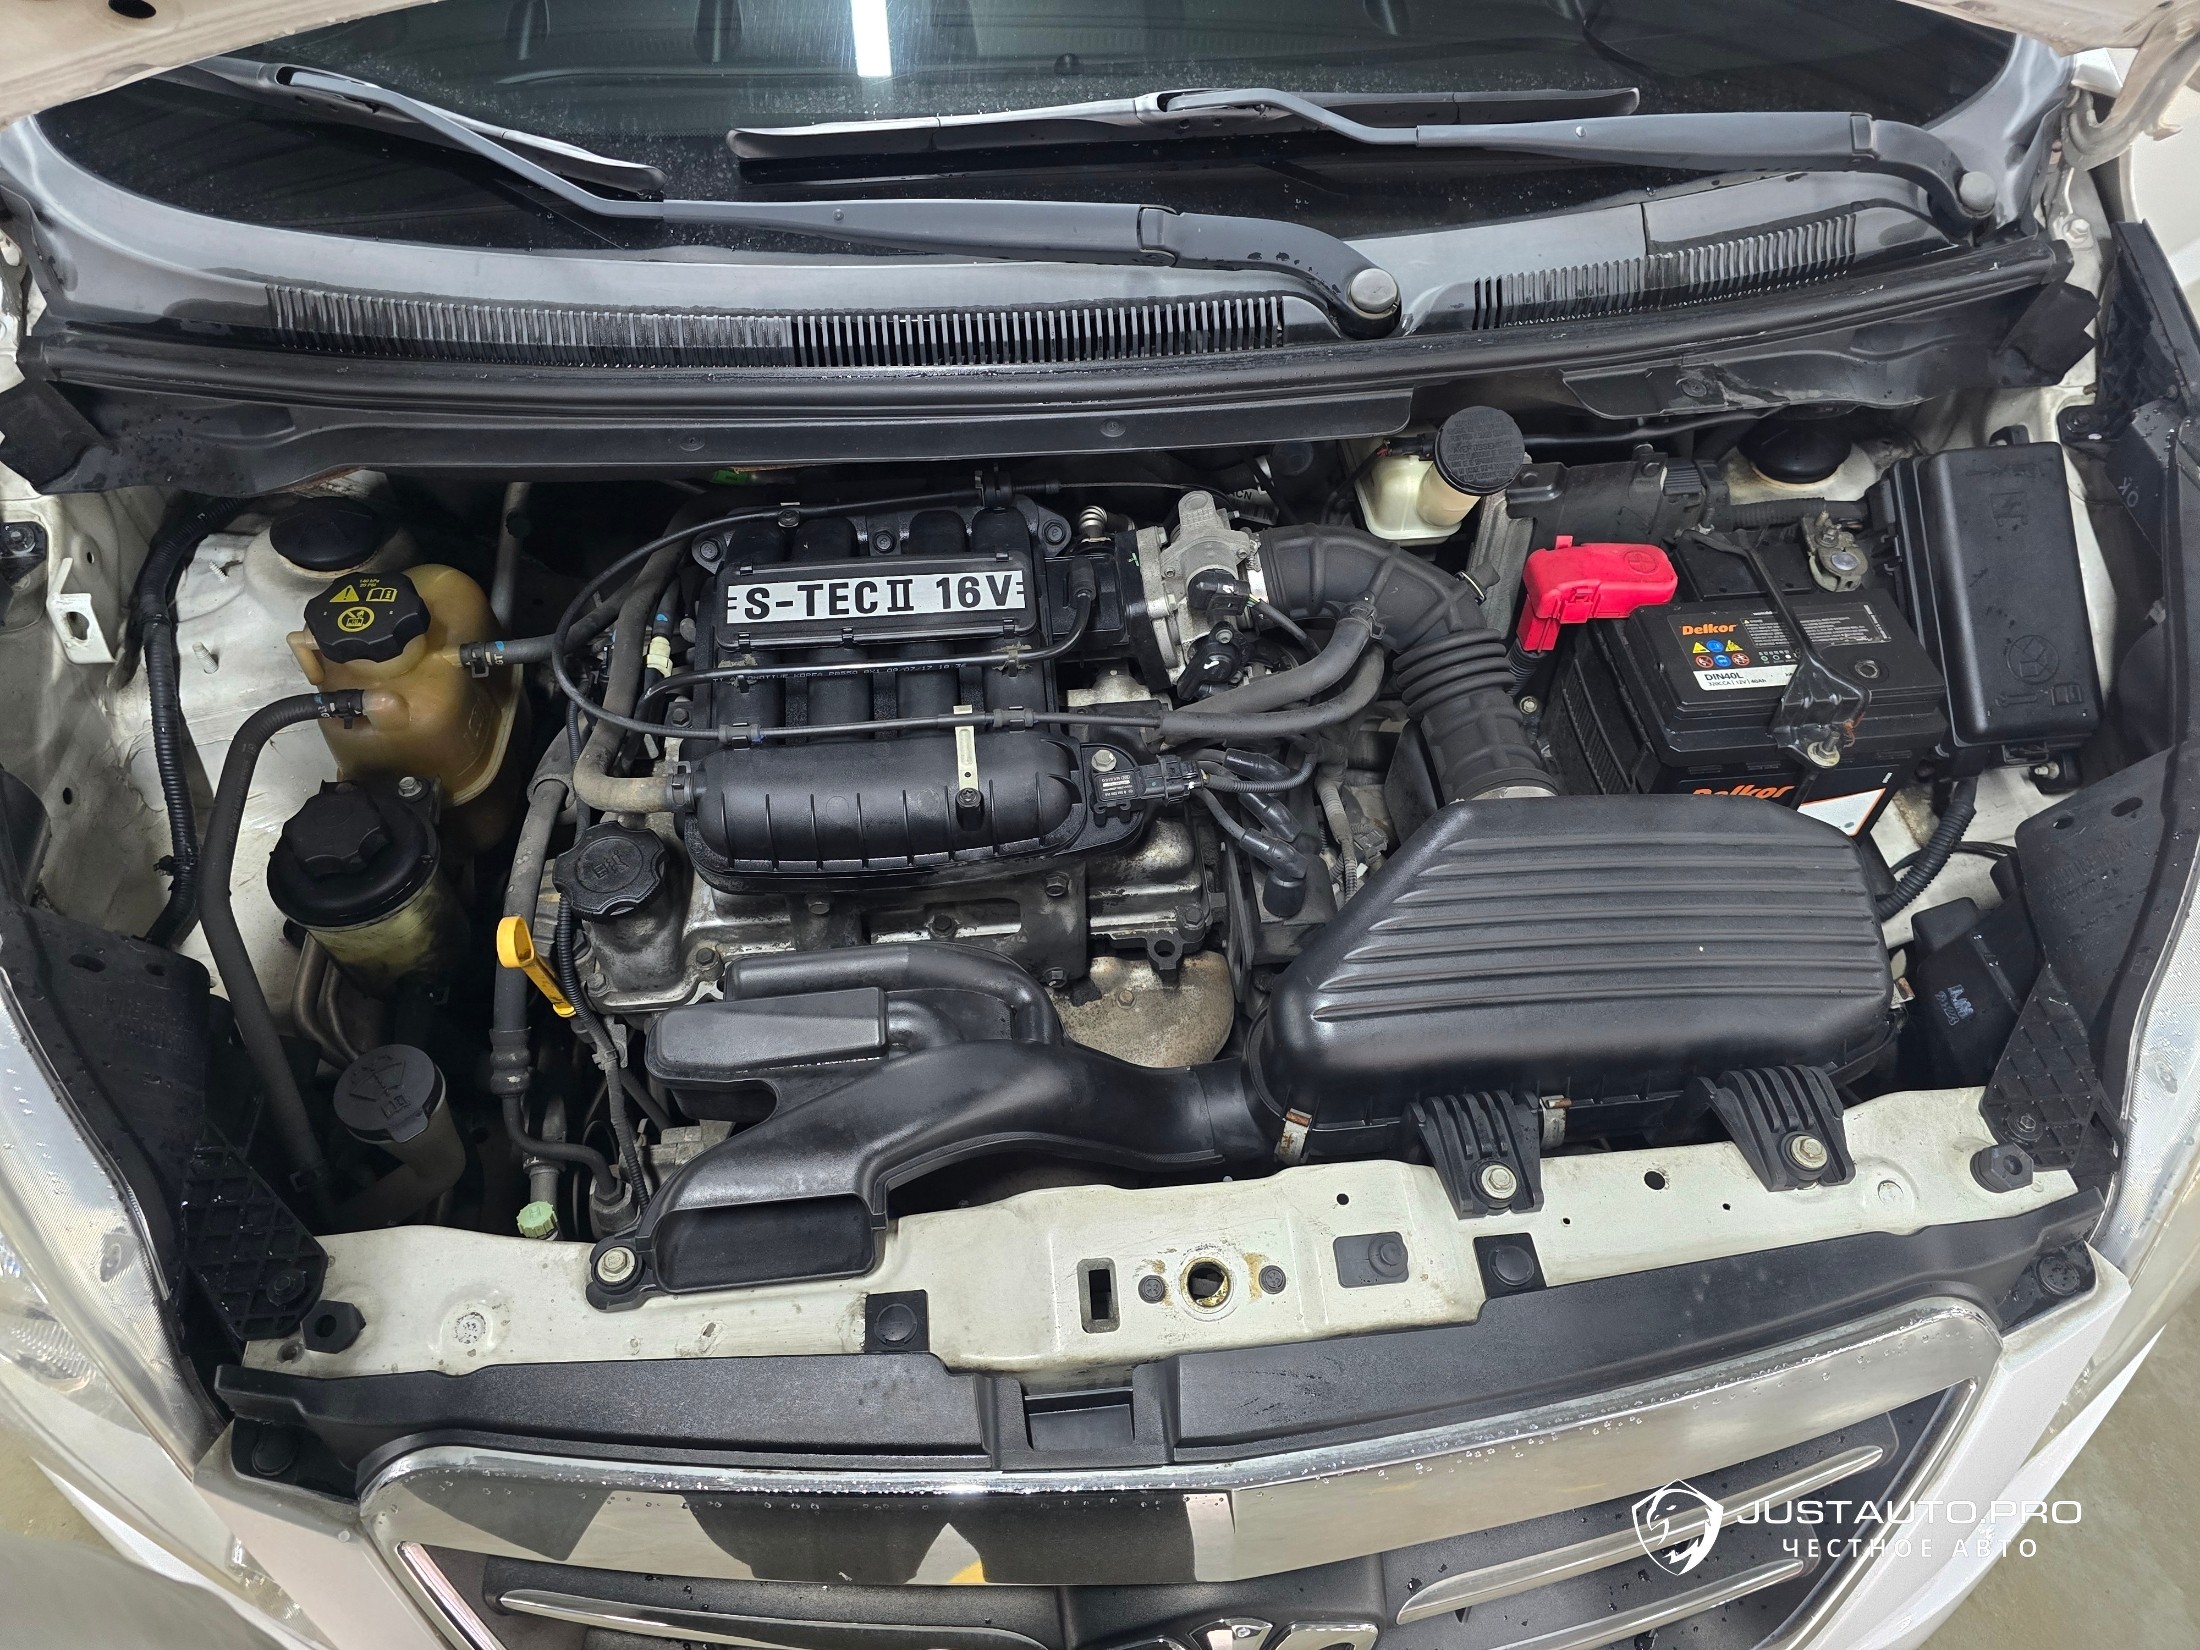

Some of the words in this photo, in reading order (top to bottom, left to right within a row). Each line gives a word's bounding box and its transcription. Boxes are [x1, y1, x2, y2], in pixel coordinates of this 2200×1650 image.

[935, 574, 1013, 609] 16V
[1682, 623, 1738, 636] Delkor
[1704, 672, 1744, 681] DIN40L
[1692, 784, 1797, 800] lkor
